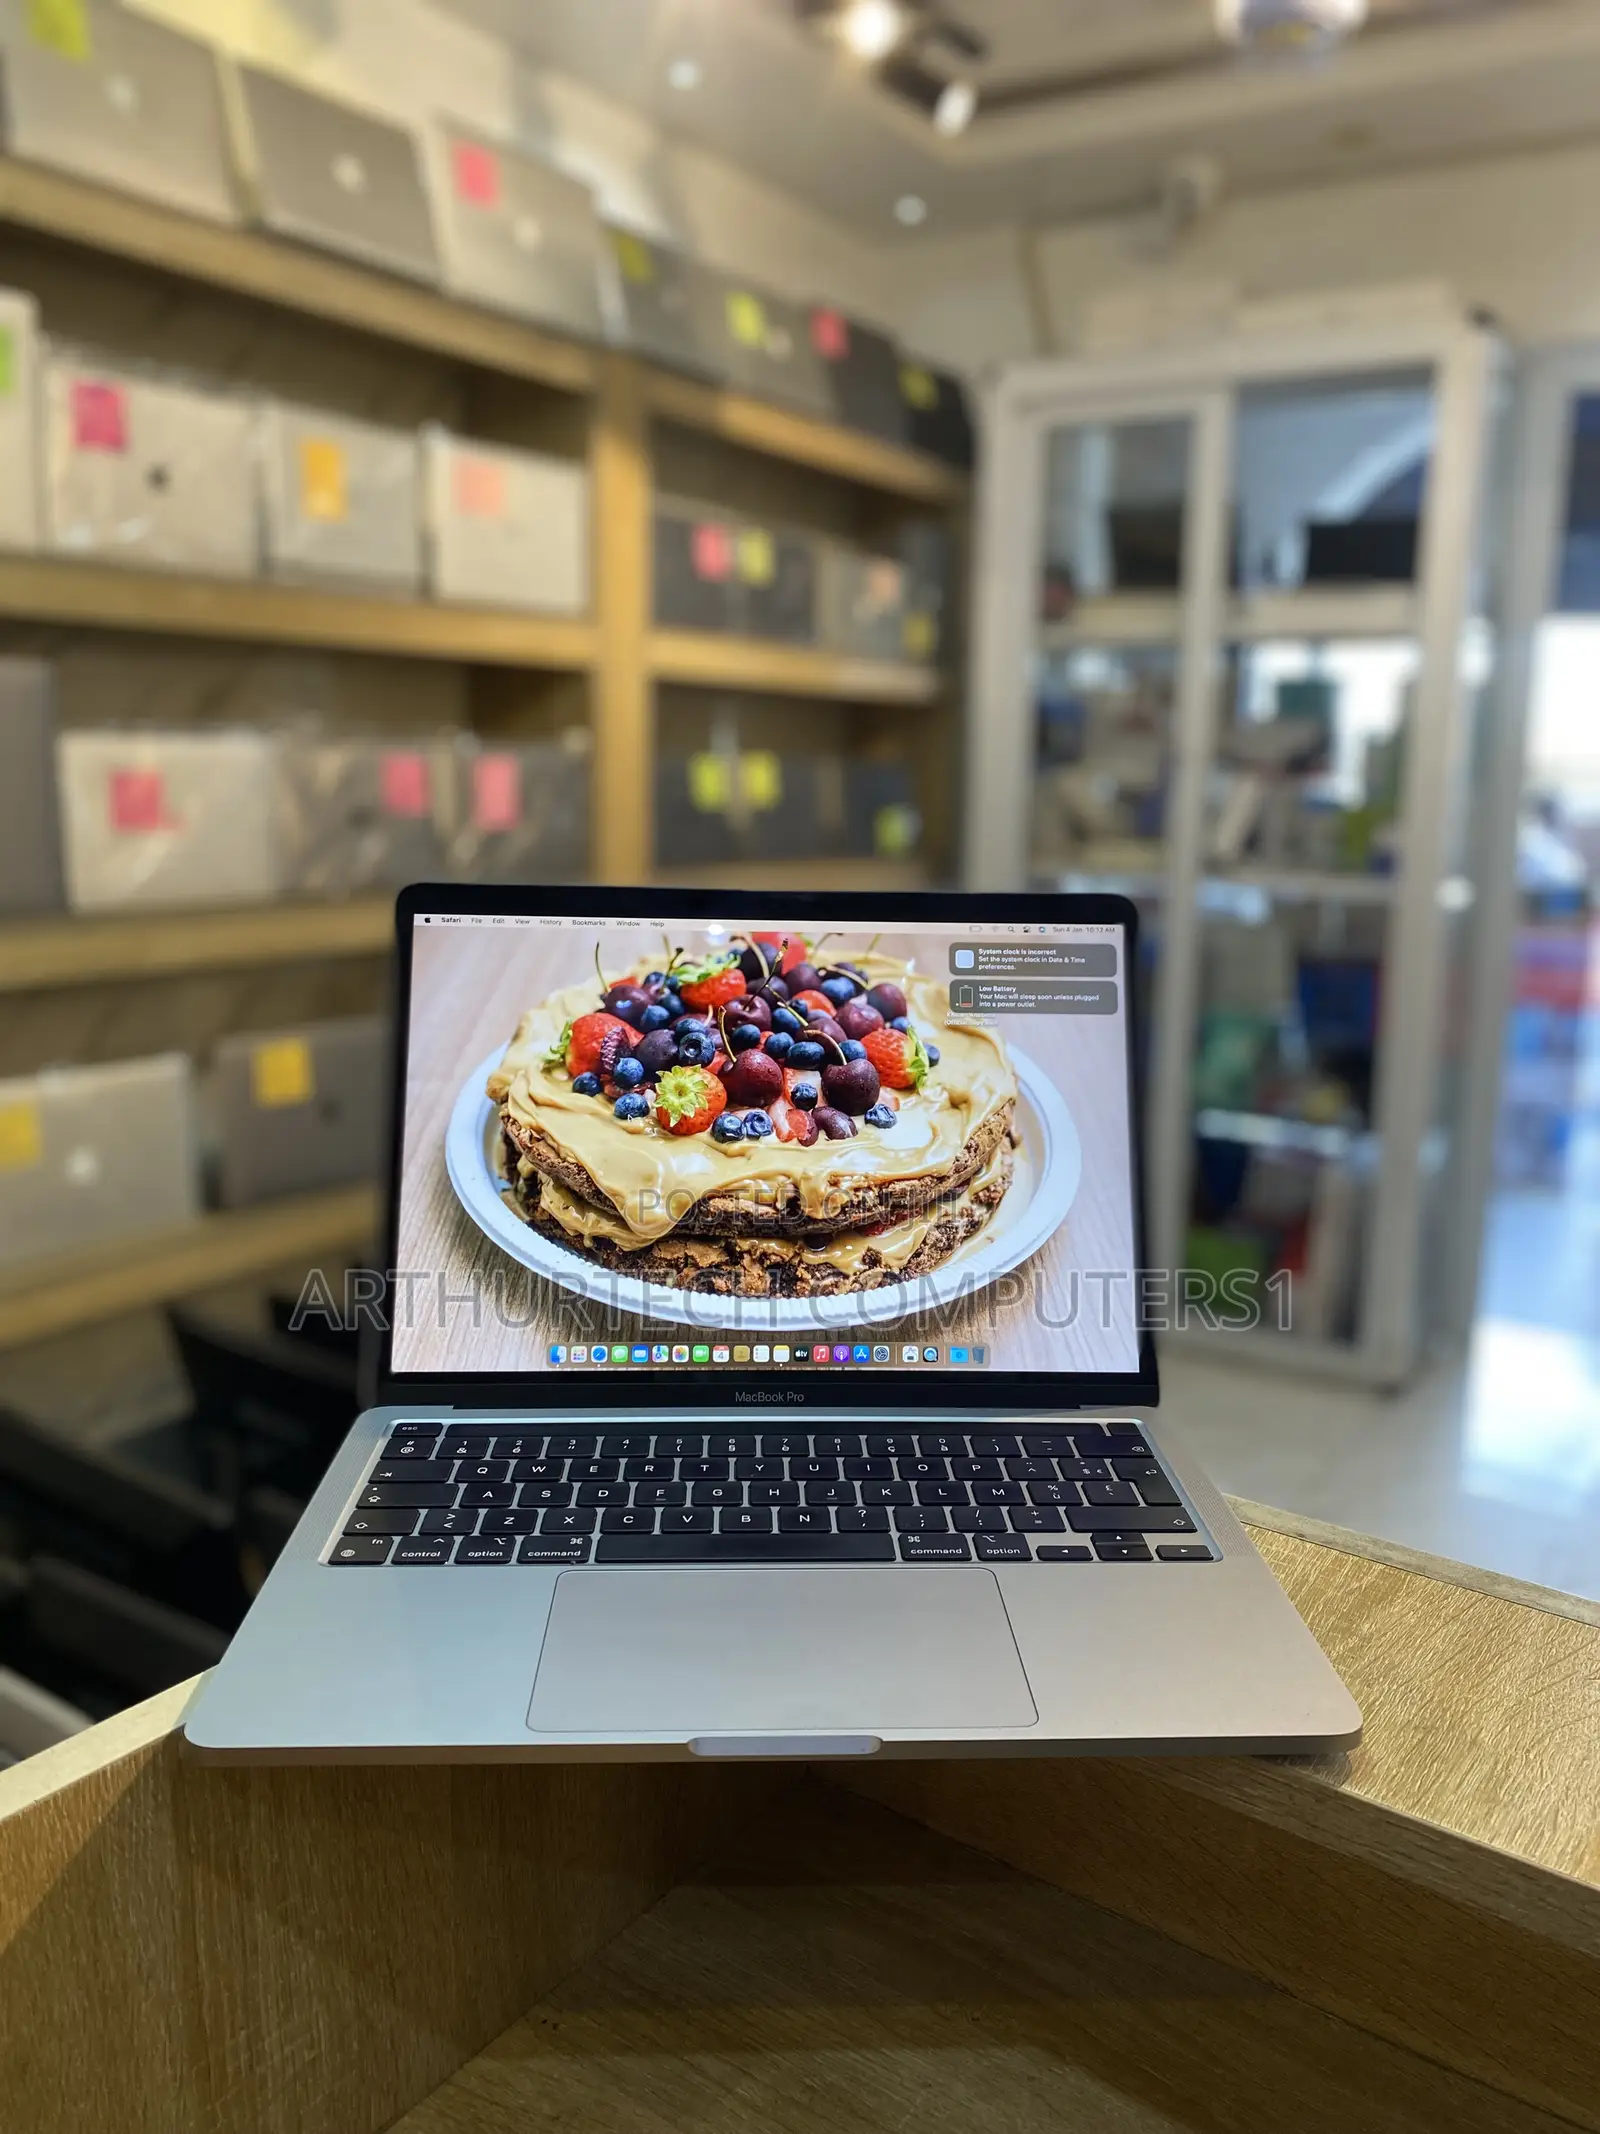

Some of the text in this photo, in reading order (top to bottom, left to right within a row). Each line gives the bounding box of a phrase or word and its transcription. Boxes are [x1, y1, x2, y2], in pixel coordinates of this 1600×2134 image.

[717, 1352, 724, 1360] 4
[735, 1391, 805, 1402] MacBook Pro
[400, 1446, 415, 1454] @
[477, 1466, 488, 1474] Q
[531, 1465, 547, 1473] W
[589, 1465, 599, 1473] E
[700, 1464, 710, 1472] T
[755, 1464, 765, 1472] Y
[809, 1464, 820, 1472] U
[971, 1464, 982, 1472] P
[541, 1490, 551, 1498] S
[598, 1489, 609, 1497] D
[656, 1489, 666, 1497] F
[769, 1488, 780, 1496] H
[827, 1488, 835, 1496] J
[881, 1488, 892, 1496] K
[938, 1488, 948, 1496] L
[992, 1488, 1005, 1496] M
[858, 1509, 867, 1518] ?
[504, 1517, 515, 1525] Z
[563, 1516, 575, 1524] X
[623, 1515, 634, 1524] C
[682, 1515, 693, 1523] V
[741, 1515, 751, 1523] B
[799, 1515, 810, 1523] N
[467, 1550, 503, 1558] option
[986, 1548, 1021, 1556] option
